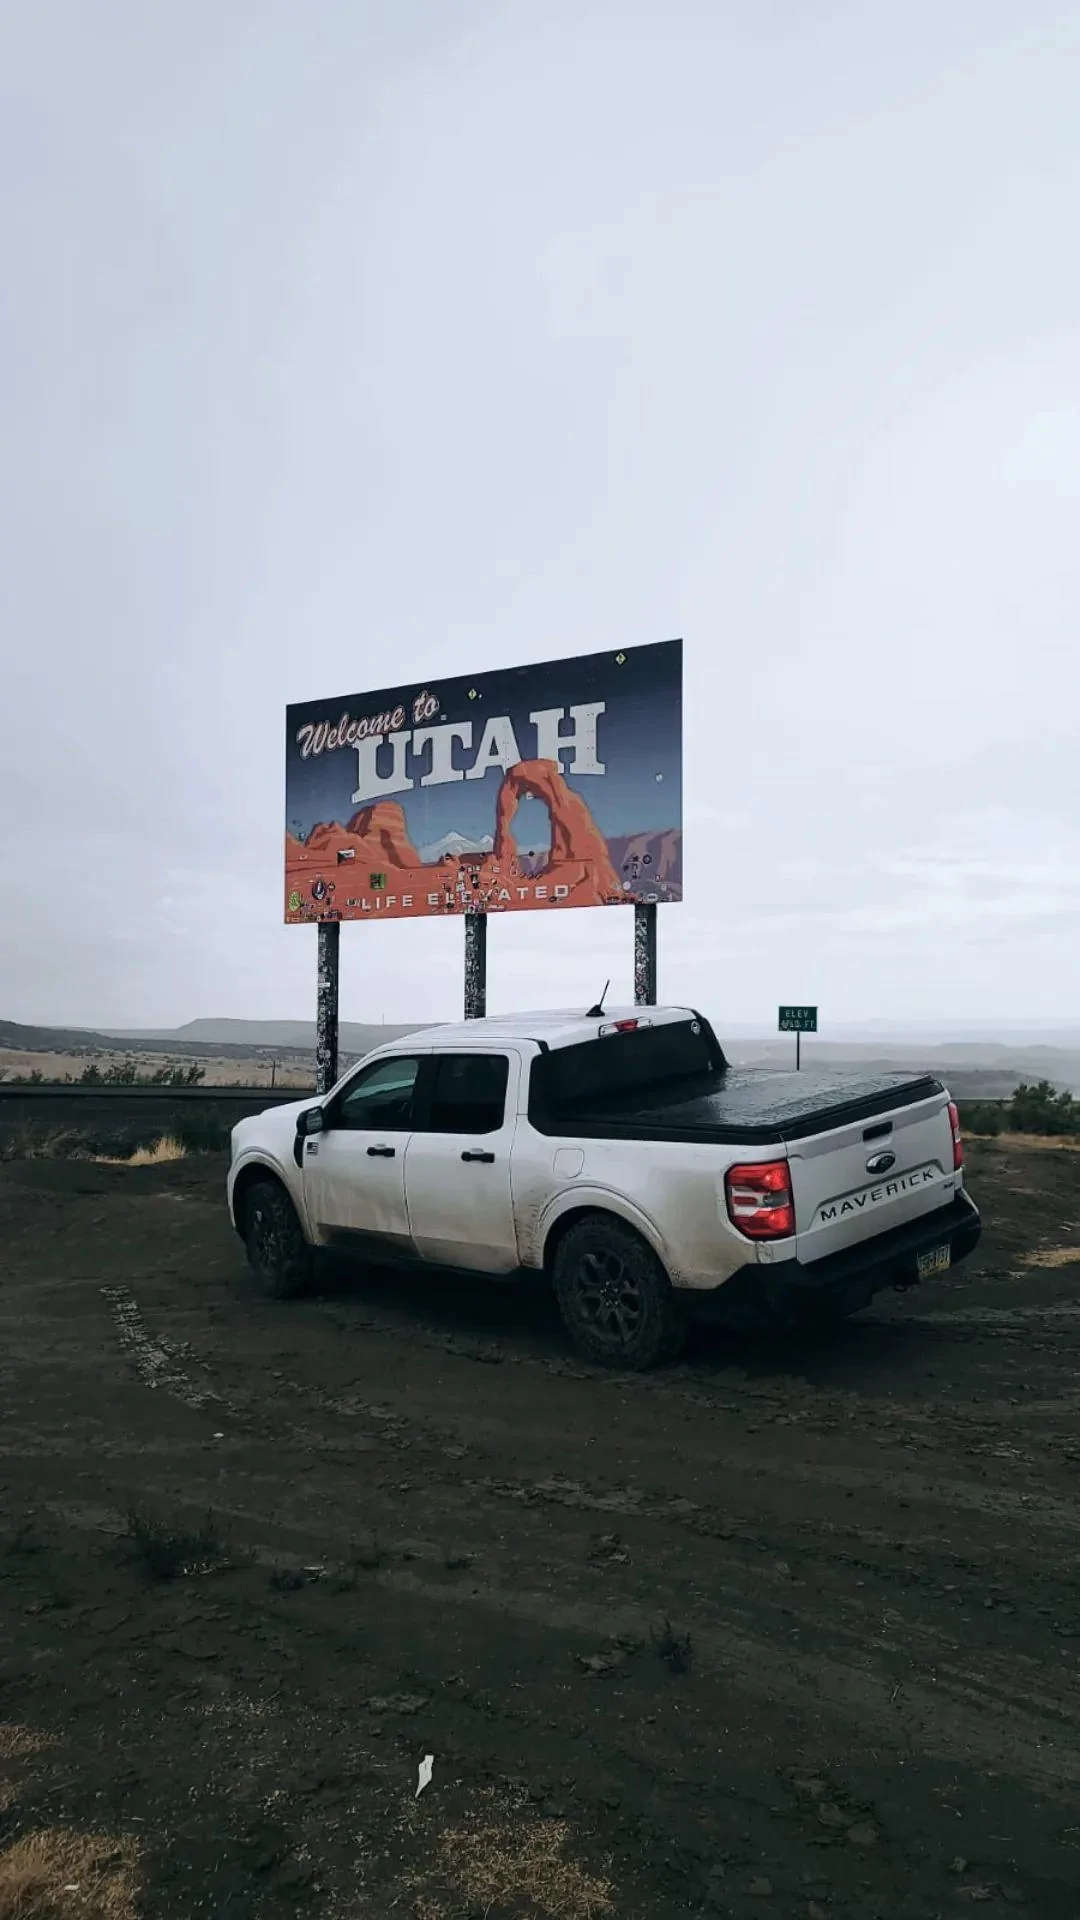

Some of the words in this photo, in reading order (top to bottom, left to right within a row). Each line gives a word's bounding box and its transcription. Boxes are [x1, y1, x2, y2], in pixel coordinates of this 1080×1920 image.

[297, 705, 405, 760] Welcome
[413, 690, 440, 724] to
[352, 702, 606, 804] UTAH
[362, 894, 413, 911] LIFE
[785, 1009, 809, 1019] ELEV
[821, 1168, 934, 1221] MAVERICK
